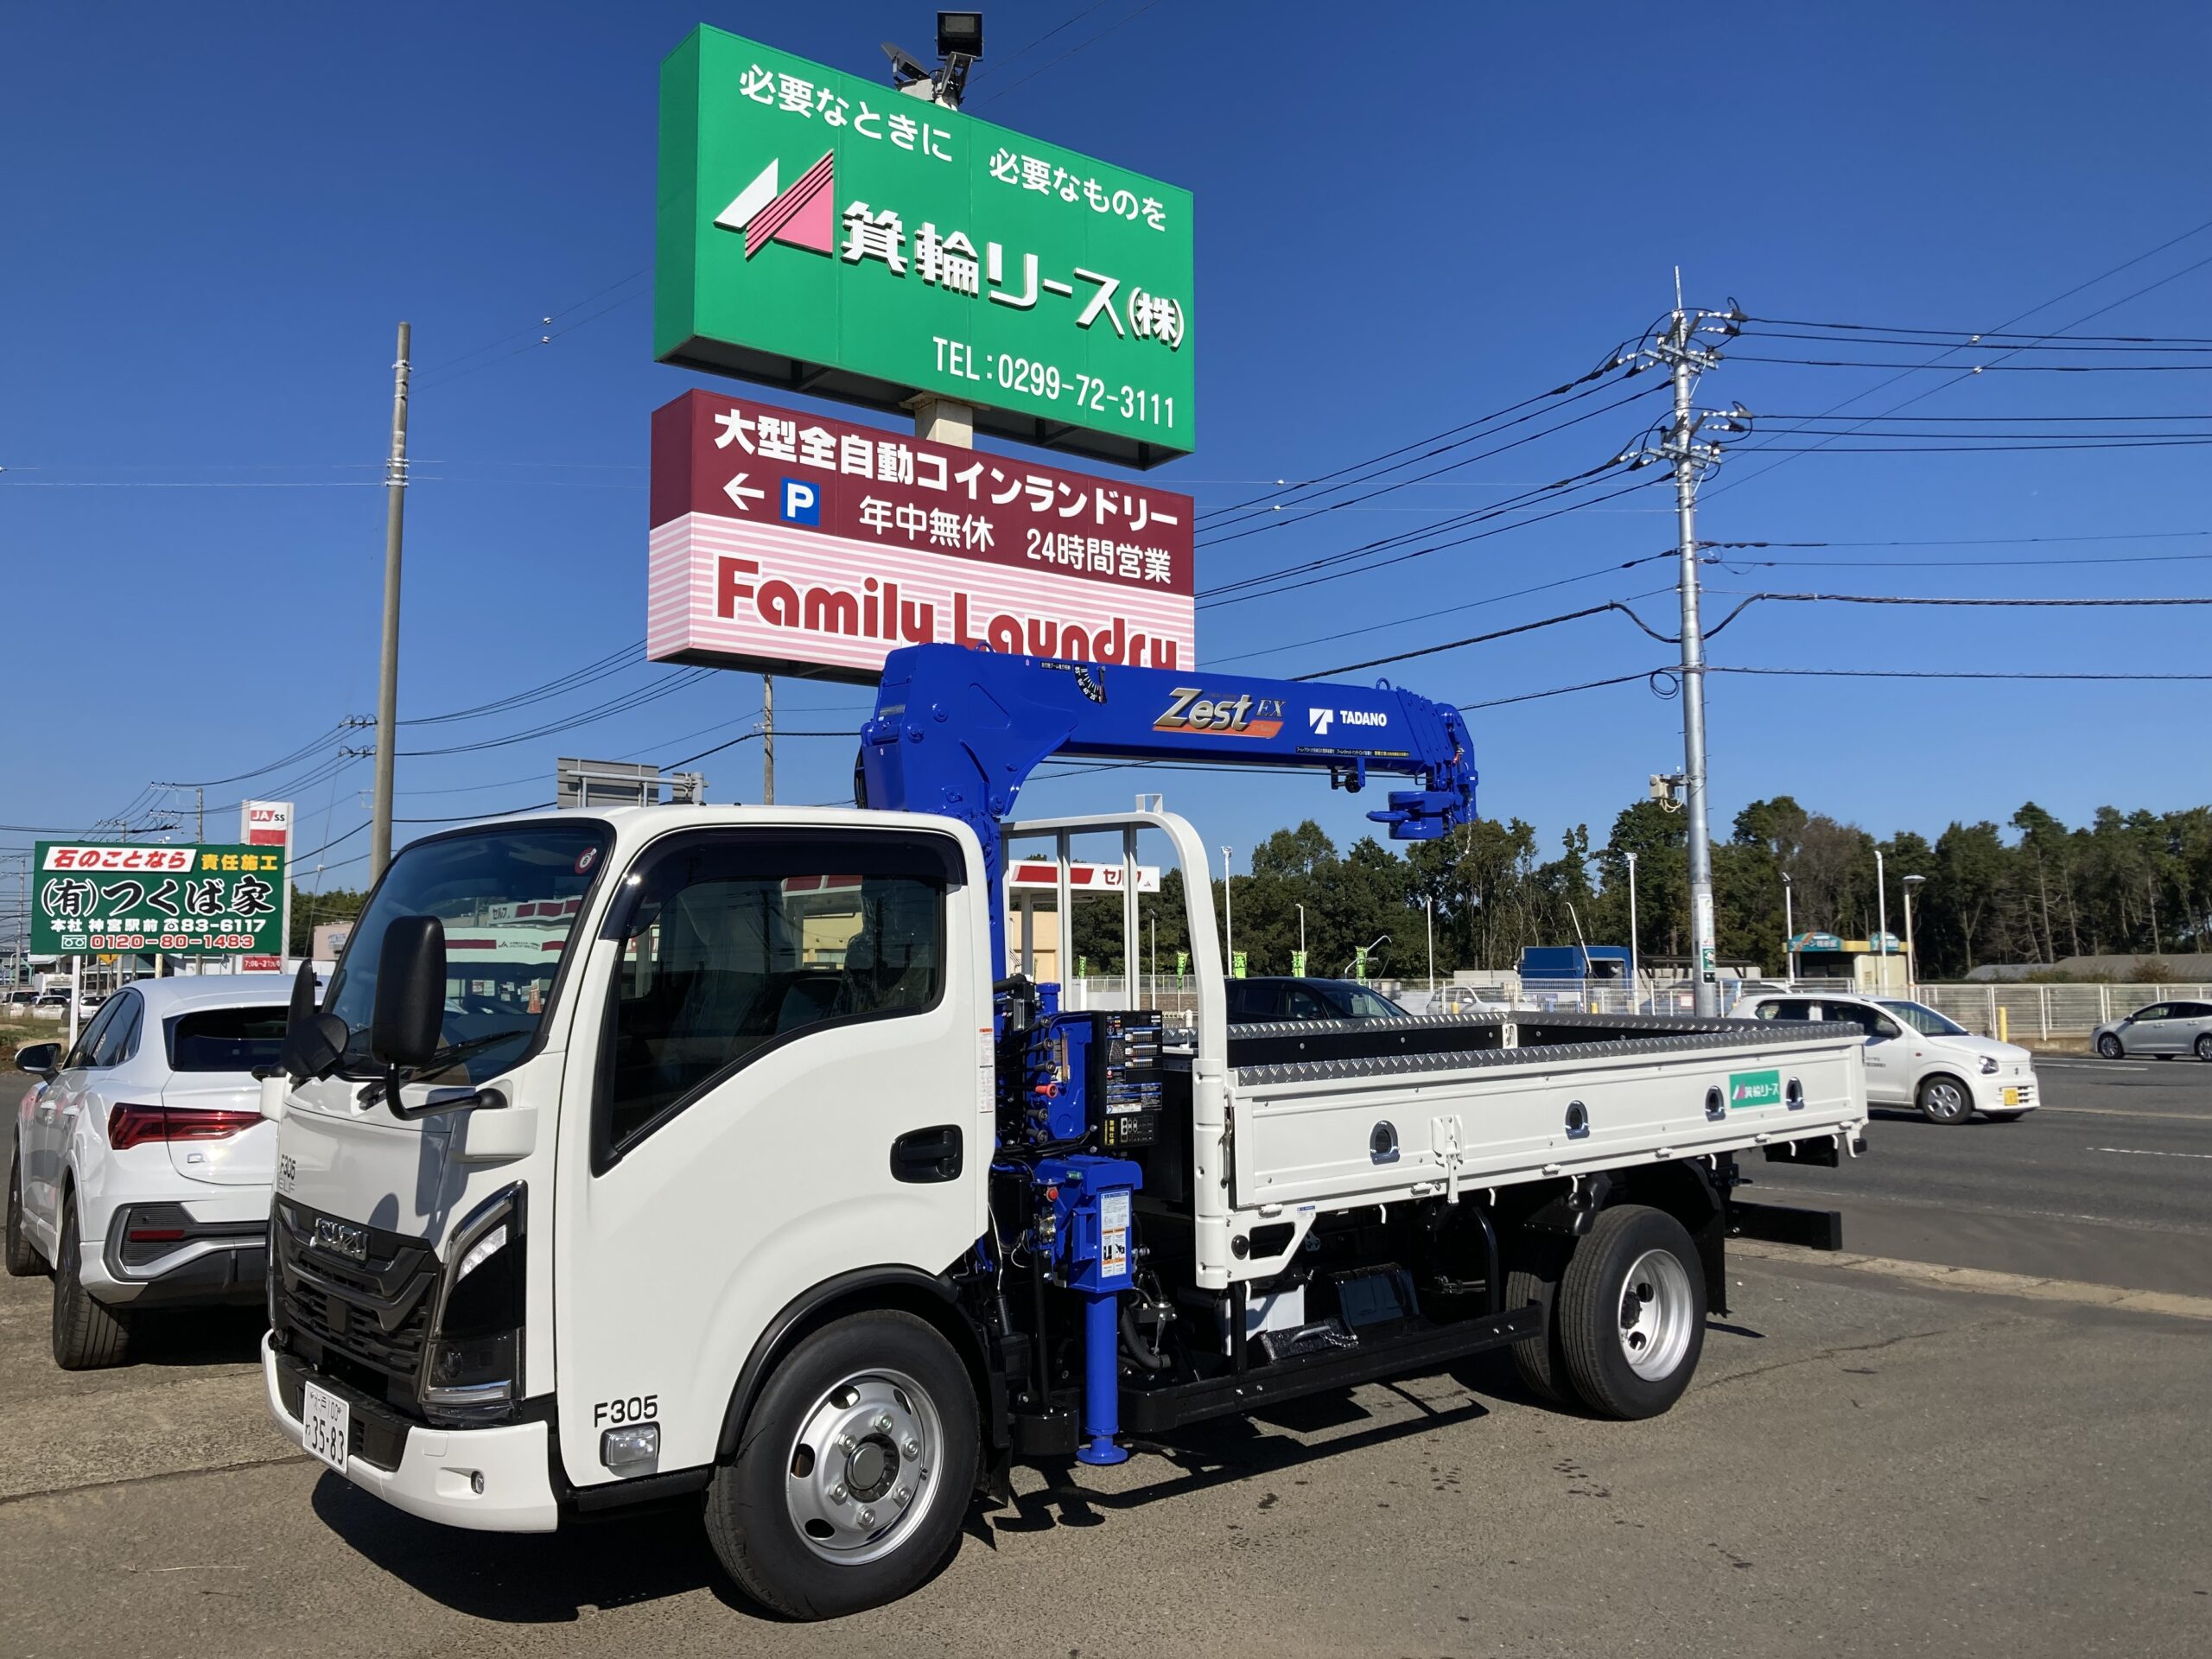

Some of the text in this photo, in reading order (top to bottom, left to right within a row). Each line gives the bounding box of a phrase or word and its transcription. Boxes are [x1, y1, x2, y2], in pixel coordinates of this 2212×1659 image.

[739, 64, 1166, 232] 必要なときに 必要なものを
[933, 336, 1174, 429] TEL:0299-72-3111
[714, 409, 1178, 531] 大型全自動コインランドリー
[786, 482, 814, 518] P
[859, 495, 1173, 585] 年中無休 24時間営業
[717, 556, 1178, 671] Family Laundry
[1153, 687, 1286, 732] Zest EX
[1339, 709, 1388, 727] TADANO
[252, 810, 270, 821] JA
[54, 849, 187, 869] 石のことなら
[201, 854, 277, 871] 責任施工
[1103, 868, 1141, 886] セル
[41, 874, 276, 918] (有)つくば家
[50, 918, 267, 933] 本社 神宮駅前 83-6117
[90, 934, 256, 950] 0120-80-1483
[281, 1154, 296, 1180] F305
[278, 1177, 295, 1193] ELF
[310, 1217, 369, 1261] ISUZU
[594, 1394, 658, 1427] F305
